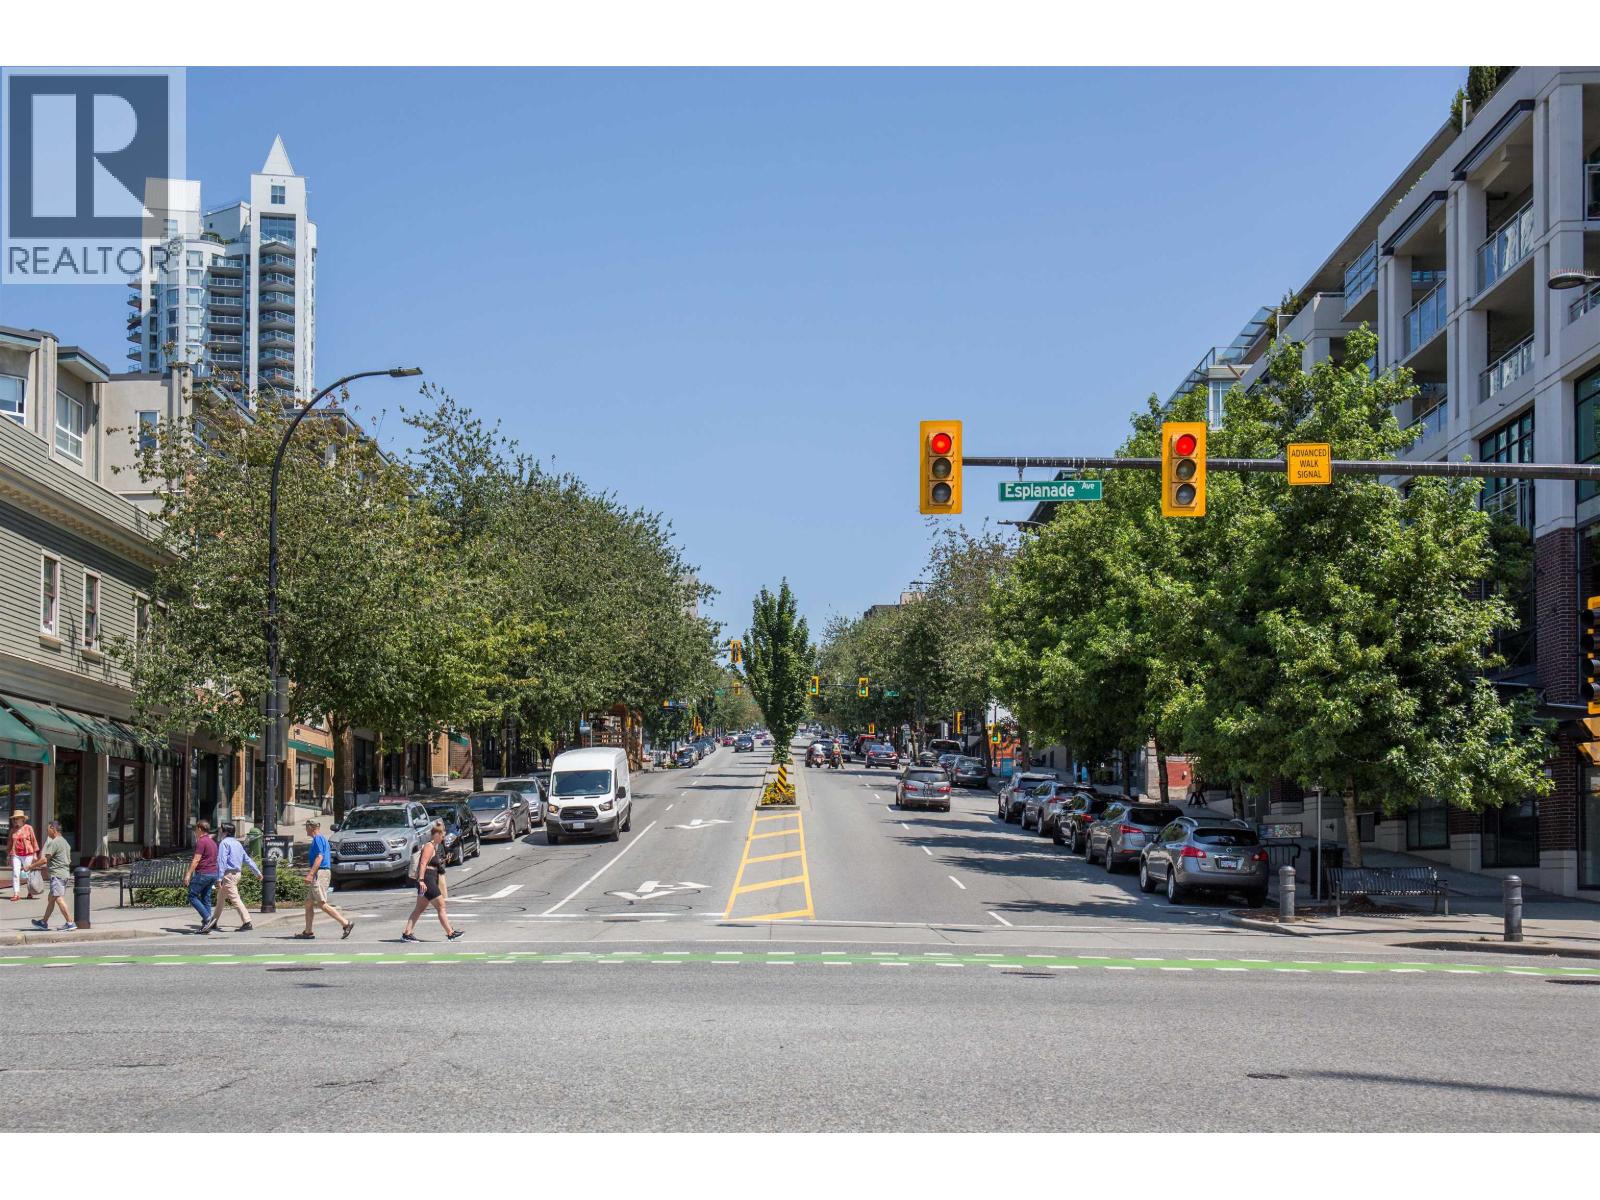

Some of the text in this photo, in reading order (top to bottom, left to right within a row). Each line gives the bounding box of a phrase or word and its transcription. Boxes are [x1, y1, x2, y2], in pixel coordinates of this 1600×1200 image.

[1291, 449, 1327, 457] ADVANCED
[1299, 459, 1319, 468] WALK
[1297, 470, 1322, 478] SIGNAL
[1005, 482, 1095, 500] Esplanade Ave
